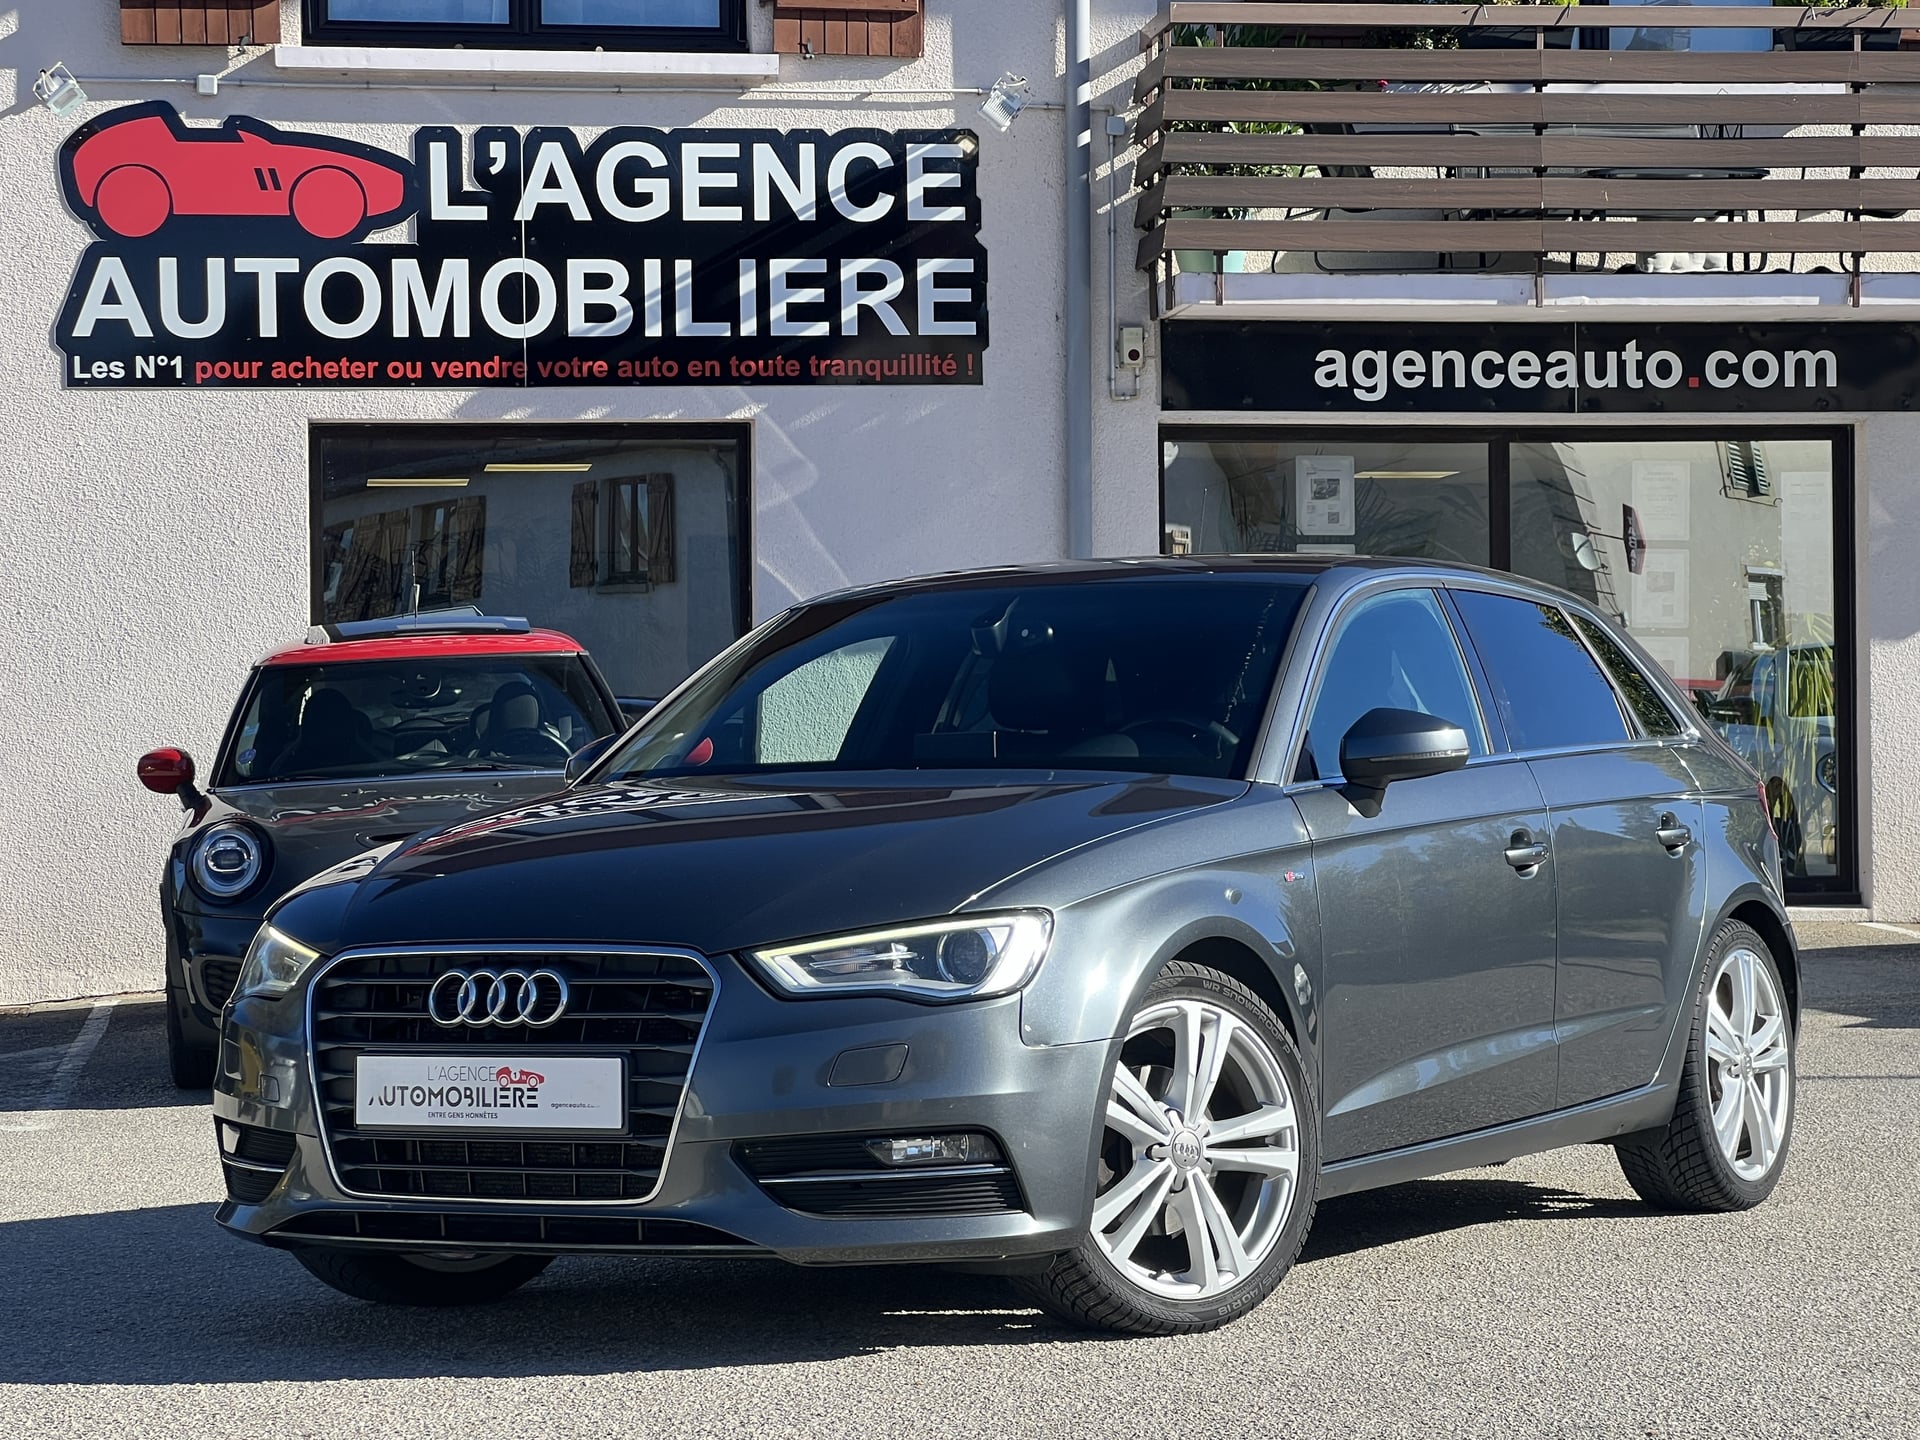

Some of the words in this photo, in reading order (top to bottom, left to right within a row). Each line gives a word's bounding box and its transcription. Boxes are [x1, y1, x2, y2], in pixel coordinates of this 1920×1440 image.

[429, 140, 966, 222] L'AGENCE
[71, 256, 977, 339] AUTOMOBILIERE
[73, 355, 126, 379] Les
[135, 355, 182, 379] N°1
[195, 360, 262, 384] pour
[271, 356, 378, 379] acheter
[387, 361, 422, 379] ou
[431, 356, 527, 379] vendre
[537, 356, 608, 378] votre
[617, 356, 678, 378] auto
[687, 359, 720, 377] en
[730, 355, 800, 377] toute
[809, 353, 957, 381] tranquillité
[1314, 339, 1838, 402] agenceauto.com
[1202, 980, 1220, 993] WR
[1223, 987, 1285, 1042] SNOWPROOF
[427, 1065, 497, 1082] L'AGENCE
[428, 1111, 447, 1119] ENTRE
[448, 1111, 464, 1119] GENS
